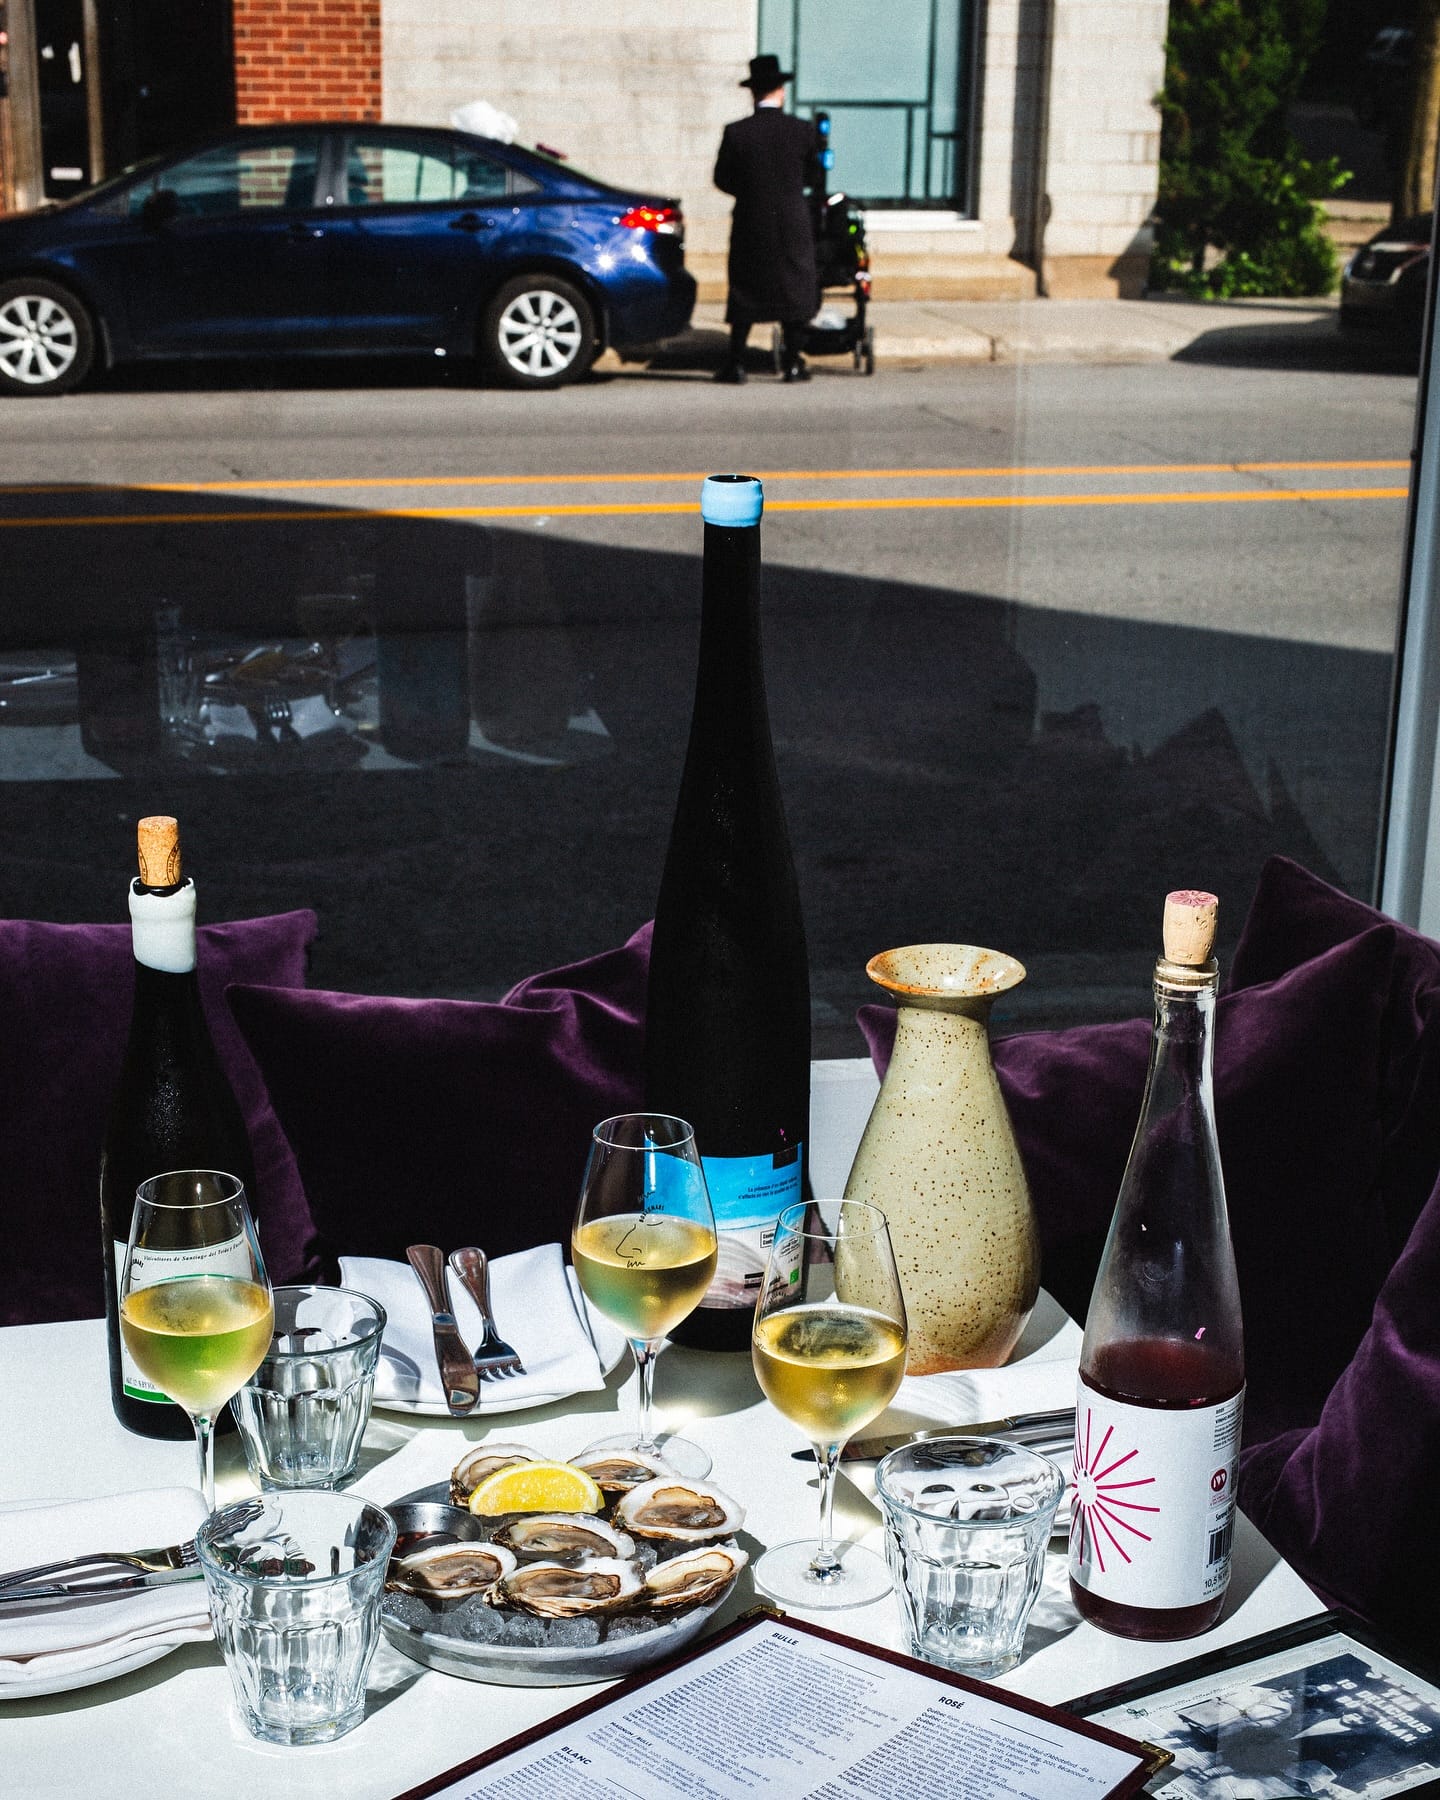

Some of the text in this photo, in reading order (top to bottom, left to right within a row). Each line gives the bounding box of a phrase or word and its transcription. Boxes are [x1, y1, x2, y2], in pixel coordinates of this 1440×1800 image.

[772, 1632, 799, 1646] BULLE
[938, 1696, 966, 1710] ROSÉ
[1336, 1678, 1358, 1690] IS
[1356, 1690, 1432, 1734] DELICIOUS
[561, 1746, 592, 1765] BLANC
